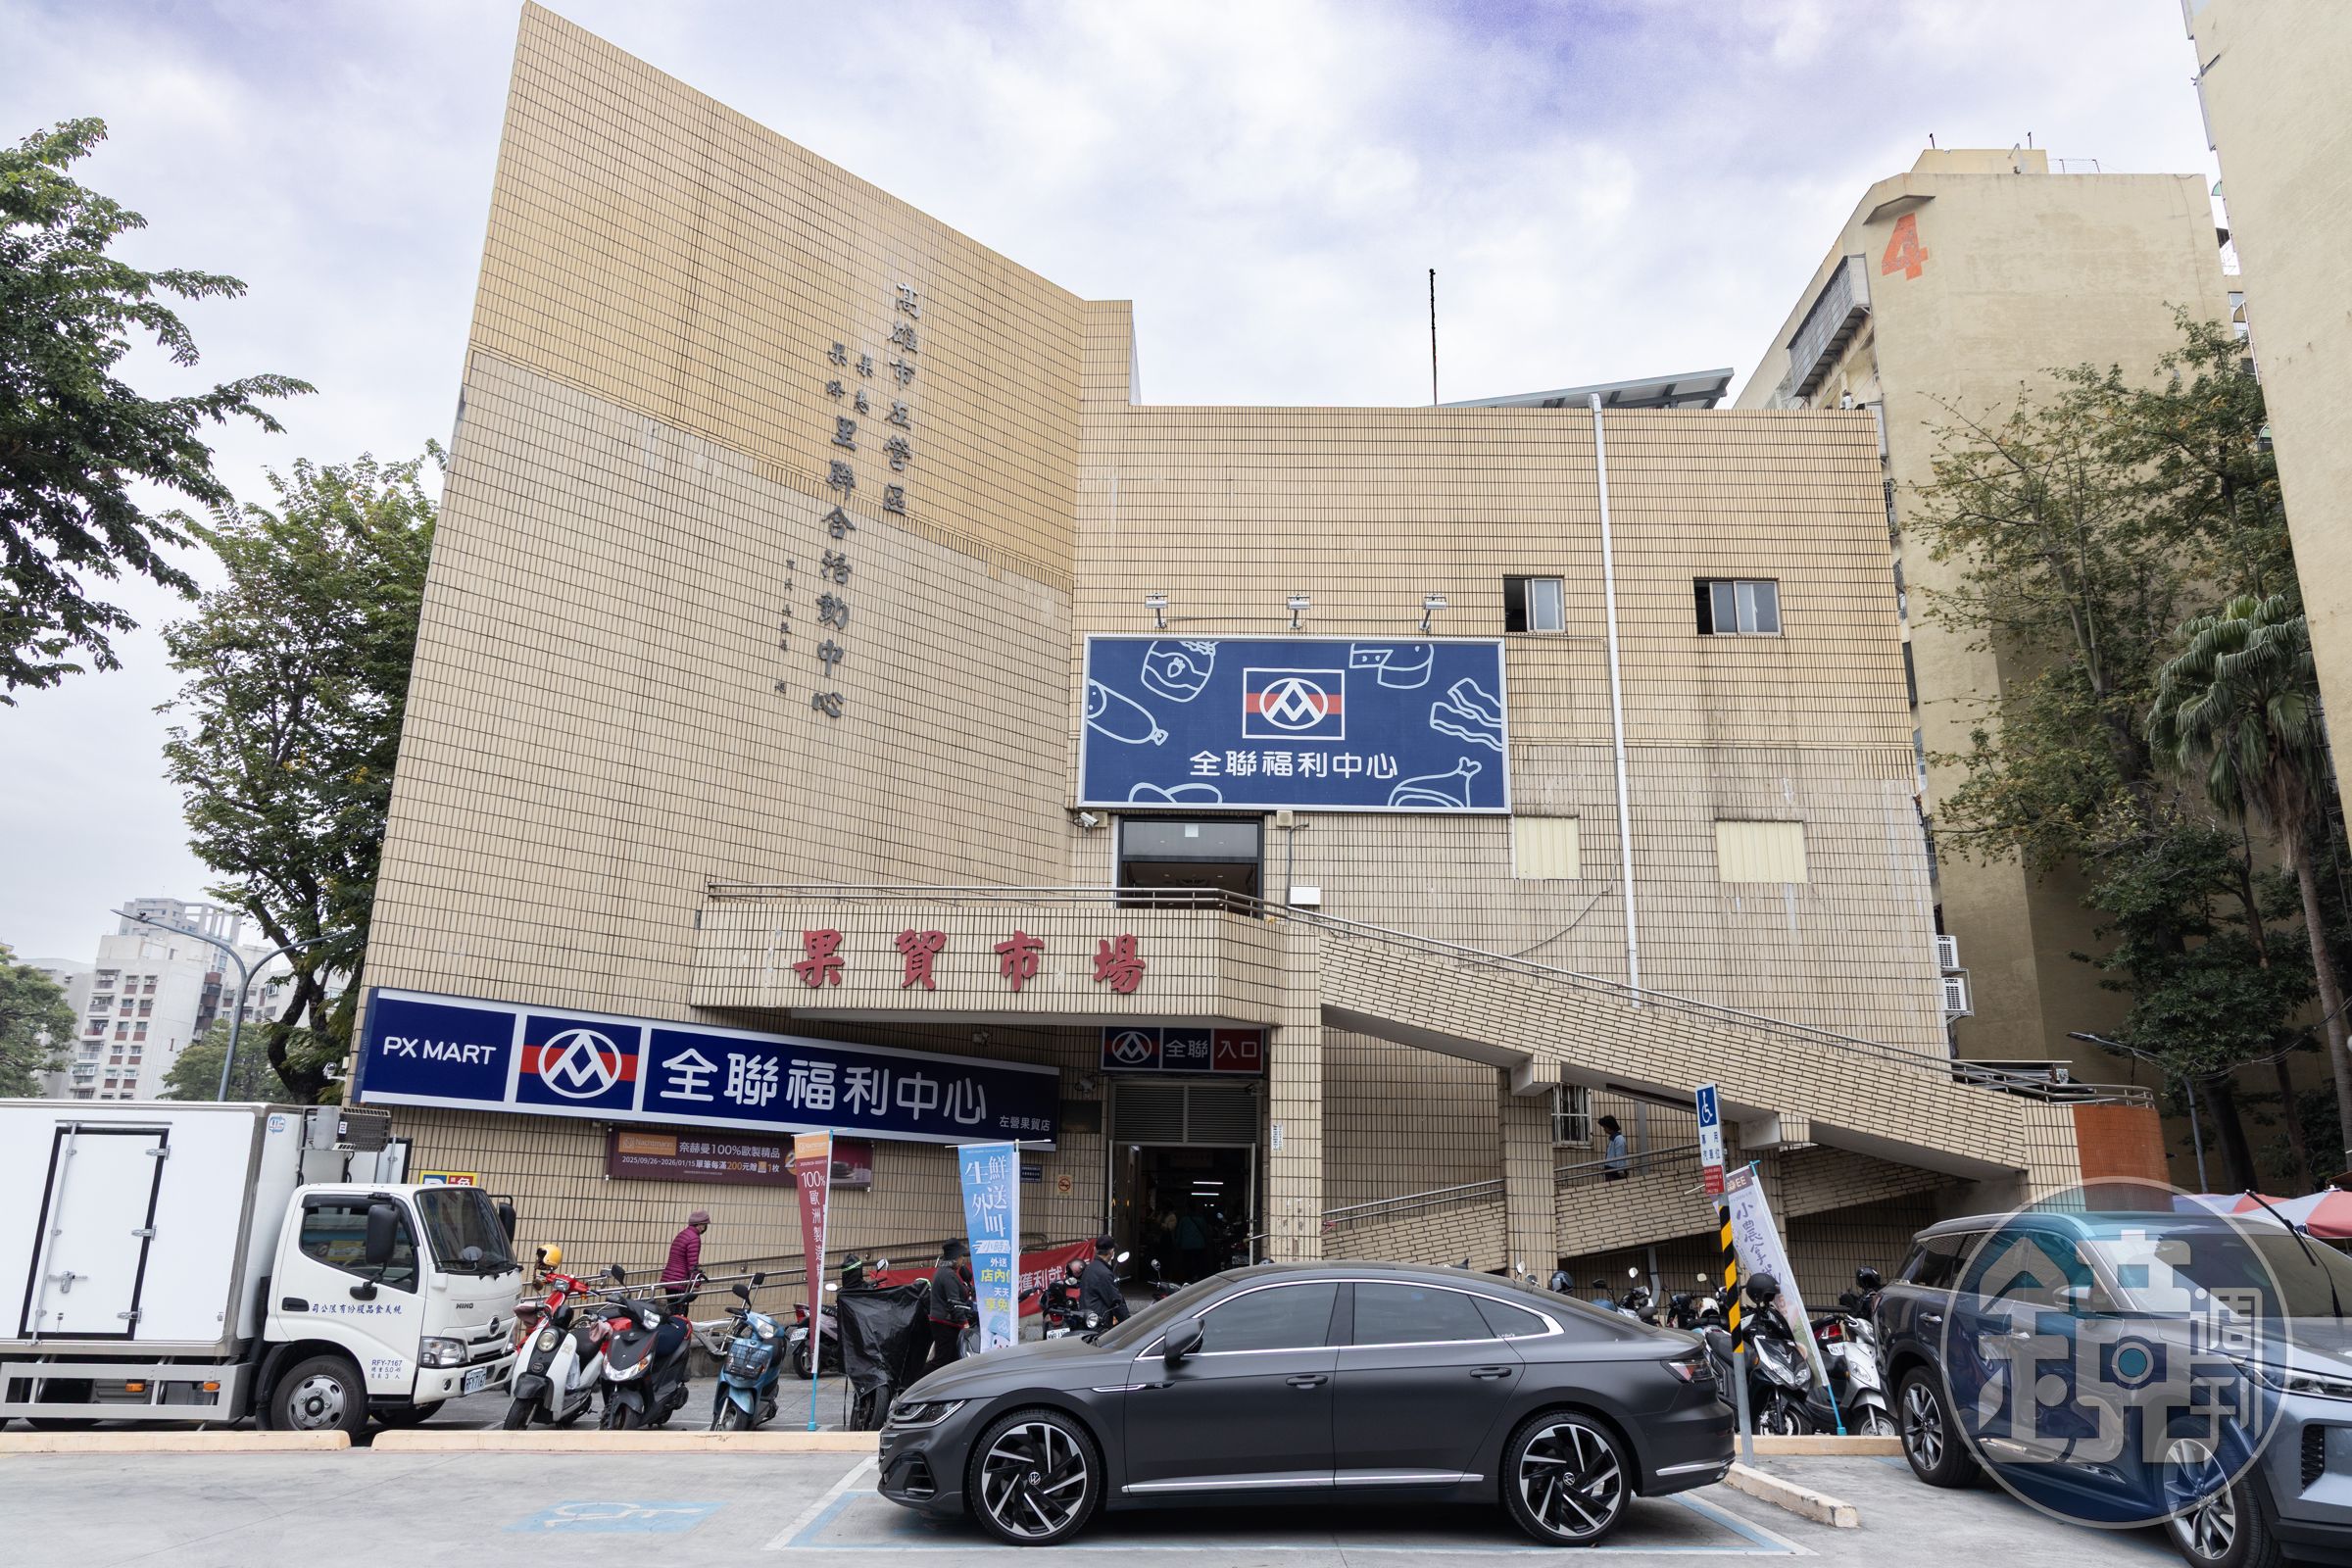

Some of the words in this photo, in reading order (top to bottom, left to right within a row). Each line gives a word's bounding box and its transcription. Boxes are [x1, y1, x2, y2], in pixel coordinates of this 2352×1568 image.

[1881, 211, 1930, 281] 4
[883, 281, 921, 516] 高雄市左營區
[1189, 750, 1398, 780] 全聯福利中心
[792, 928, 1147, 995] 果貿市場
[382, 1035, 418, 1058] PX
[422, 1040, 497, 1065] MART
[1165, 1039, 1208, 1058] 全聯
[1217, 1040, 1257, 1059] 入口
[660, 1048, 987, 1125] 全聯福利中心
[999, 1115, 1052, 1133] 左營果貿店
[679, 1141, 781, 1159] 奈赫曼100%歐製精品
[801, 1171, 826, 1188] 100%
[990, 1257, 1007, 1267] 外送
[994, 1287, 1009, 1298] 天天
[986, 1298, 1010, 1312] 享免
